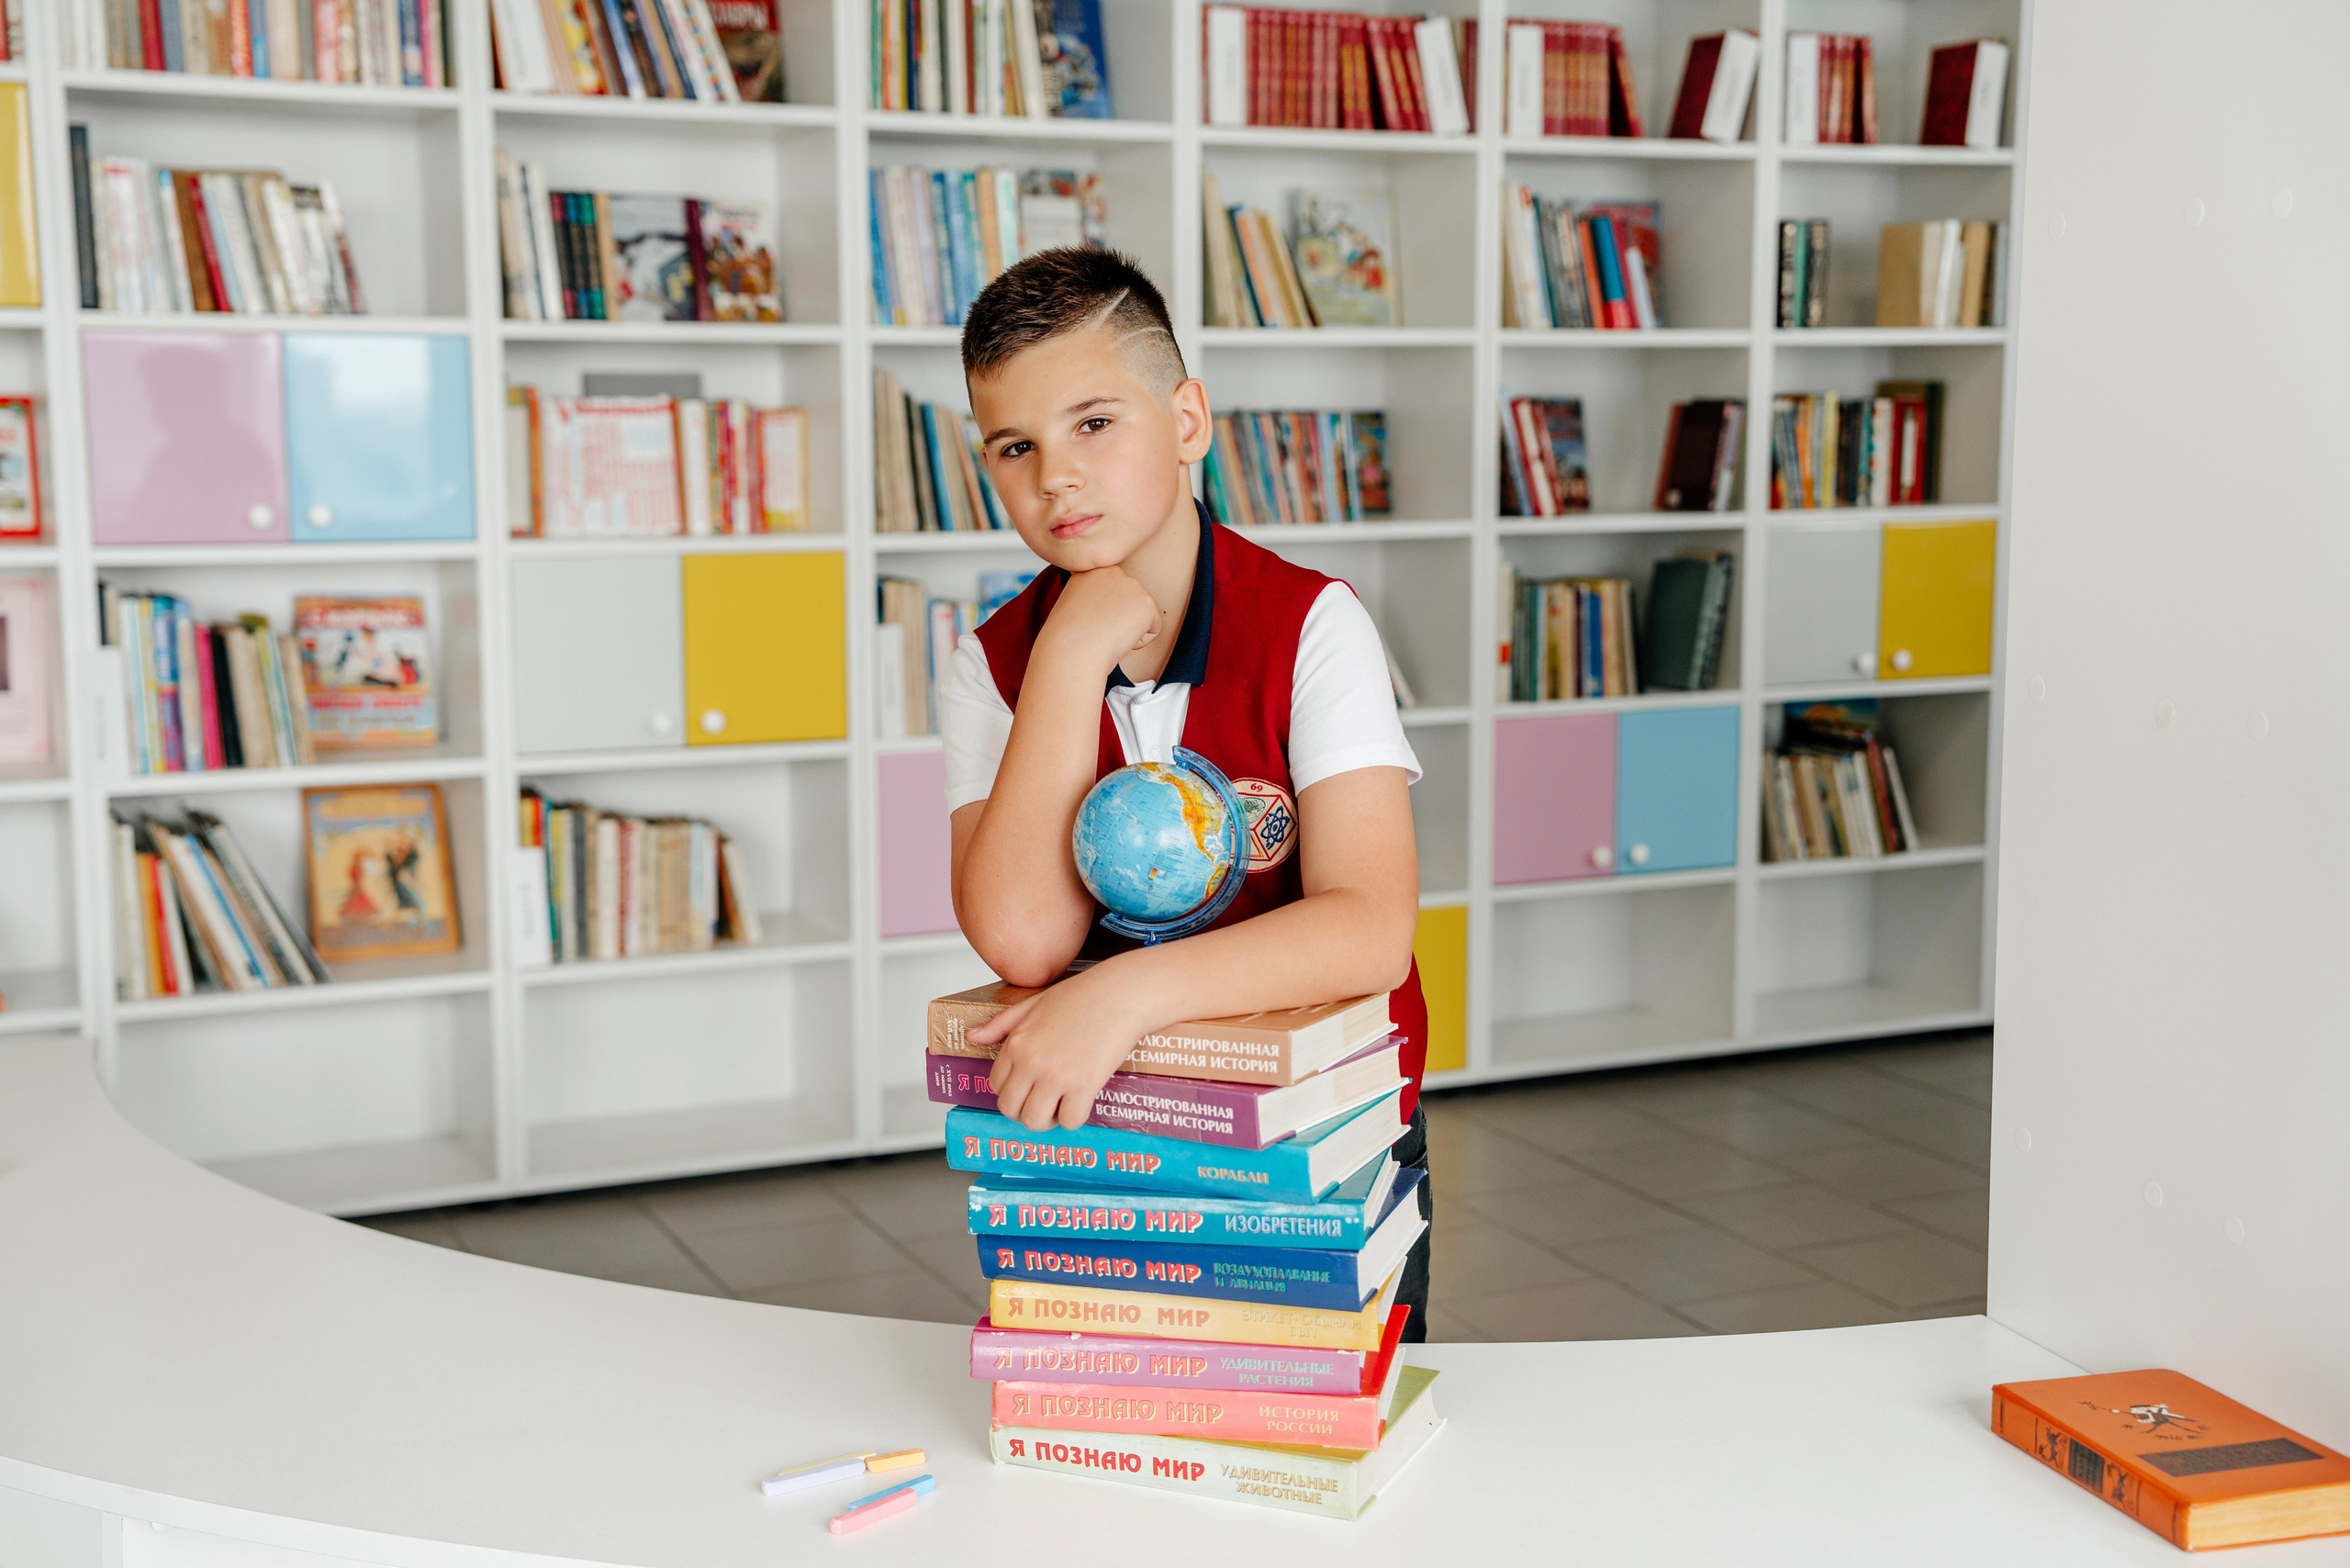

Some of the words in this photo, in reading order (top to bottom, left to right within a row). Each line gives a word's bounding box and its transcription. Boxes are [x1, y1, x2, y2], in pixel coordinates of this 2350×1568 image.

[1250, 783, 1263, 792] 69
[1138, 1034, 1280, 1058] ЛЮСТРИРОВАННАЯ
[1210, 1057, 1278, 1073] ИСТОРИЯ
[957, 1073, 969, 1091] Я
[1095, 1090, 1234, 1120] ИЛЛЮСТРИРОВАННАЯ
[1095, 1103, 1170, 1126] ВСЕМИРНАЯ
[1172, 1114, 1234, 1135] ИСТОРИЯ
[963, 1136, 980, 1158] Я
[989, 1137, 1098, 1169] ПОЗНАЮ
[1106, 1149, 1161, 1174] МИР
[1197, 1166, 1270, 1184] КОРАБЛИ
[988, 1204, 1007, 1227] Я
[1017, 1204, 1136, 1230] ПОЗНАЮ
[1145, 1209, 1203, 1233] МИР
[1225, 1215, 1343, 1237] ИЗОБРЕТЕНИЯ
[996, 1249, 1015, 1269] Я
[1024, 1250, 1137, 1278] ПОЗНАЮ
[1145, 1260, 1203, 1283] МИР
[1214, 1261, 1332, 1283] ВОЗДУХОПЛАВАНИЕ
[1214, 1276, 1225, 1287] И
[1230, 1278, 1286, 1292] АВИАЦИЯ
[1008, 1297, 1024, 1317] Я
[1035, 1299, 1141, 1324] ПОЗНАЮ
[1158, 1307, 1211, 1327] МИР
[1242, 1309, 1293, 1325] ЭТИКЕТ
[1289, 1326, 1319, 1338] БЫТ
[993, 1346, 1013, 1369] Я
[1023, 1348, 1140, 1374] ПОЗНАЮ
[1149, 1354, 1208, 1377] МИР
[1219, 1356, 1334, 1375] УДИВИТЕЛЬНЫЕ
[1238, 1372, 1313, 1387] РАСТЕНИЯ
[1012, 1394, 1031, 1416] Я
[1040, 1394, 1156, 1420] ПОЗНАЮ
[1166, 1401, 1224, 1423] МИР
[1259, 1406, 1339, 1422] ИСТОРИЯ
[1267, 1420, 1333, 1435] РОССИИ
[1009, 1439, 1025, 1458] Я
[1035, 1441, 1142, 1473] ПОЗНАЮ
[1152, 1456, 1205, 1482] МИР
[1220, 1463, 1338, 1493] УДИВИТЕЛЬНЫЕ
[1236, 1480, 1323, 1506] ЖИВОТНЫЕ
